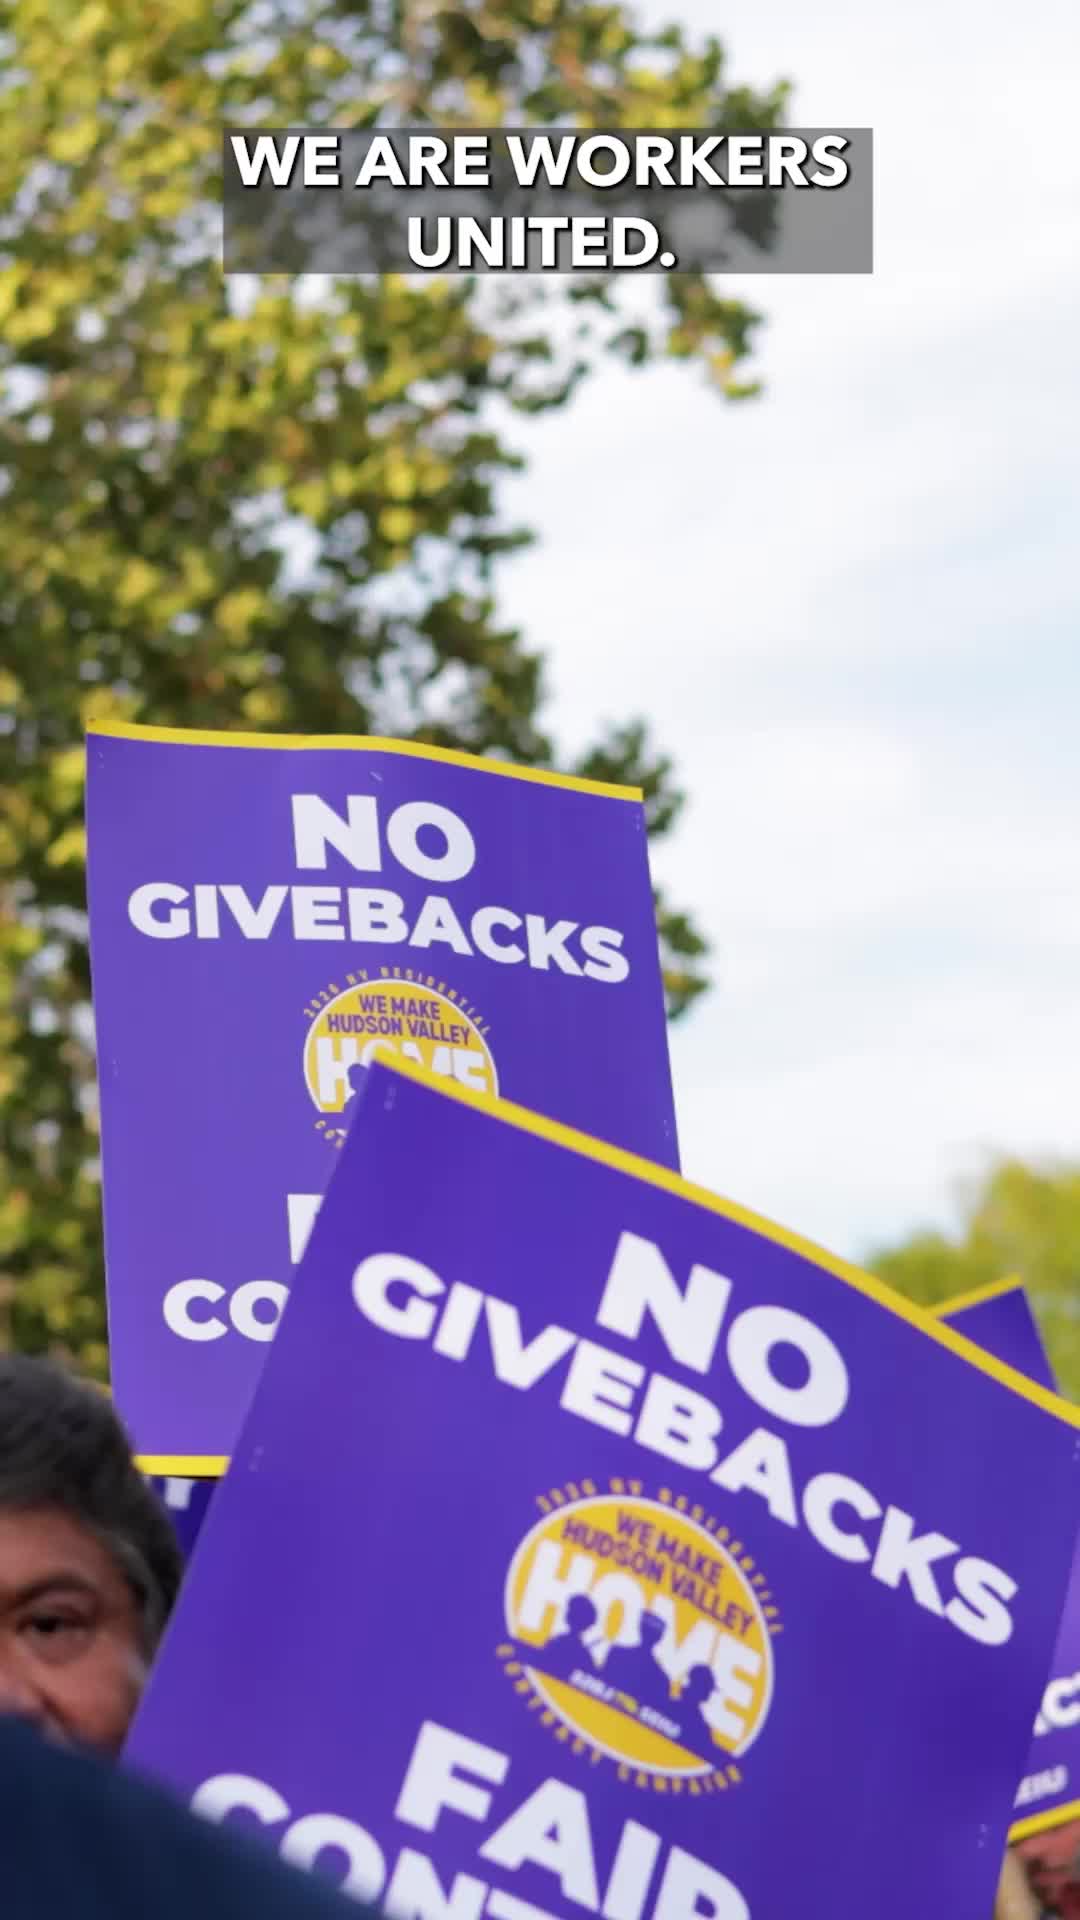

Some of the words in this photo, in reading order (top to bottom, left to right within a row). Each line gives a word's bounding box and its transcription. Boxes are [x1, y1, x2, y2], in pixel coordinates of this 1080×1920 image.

[291, 794, 476, 882] NO
[128, 882, 630, 983] GIVEBACKS
[327, 1014, 403, 1037] HUDSON
[406, 1018, 471, 1047] VALLEY
[357, 994, 387, 1014] WE
[390, 996, 441, 1021] MAKE
[596, 1230, 849, 1427] NO
[352, 1253, 1018, 1646] GIVEBACKS
[561, 1517, 665, 1584] HUDSON
[671, 1566, 757, 1638] VALLEY
[616, 1509, 654, 1547] WE
[656, 1530, 723, 1587] MAKE
